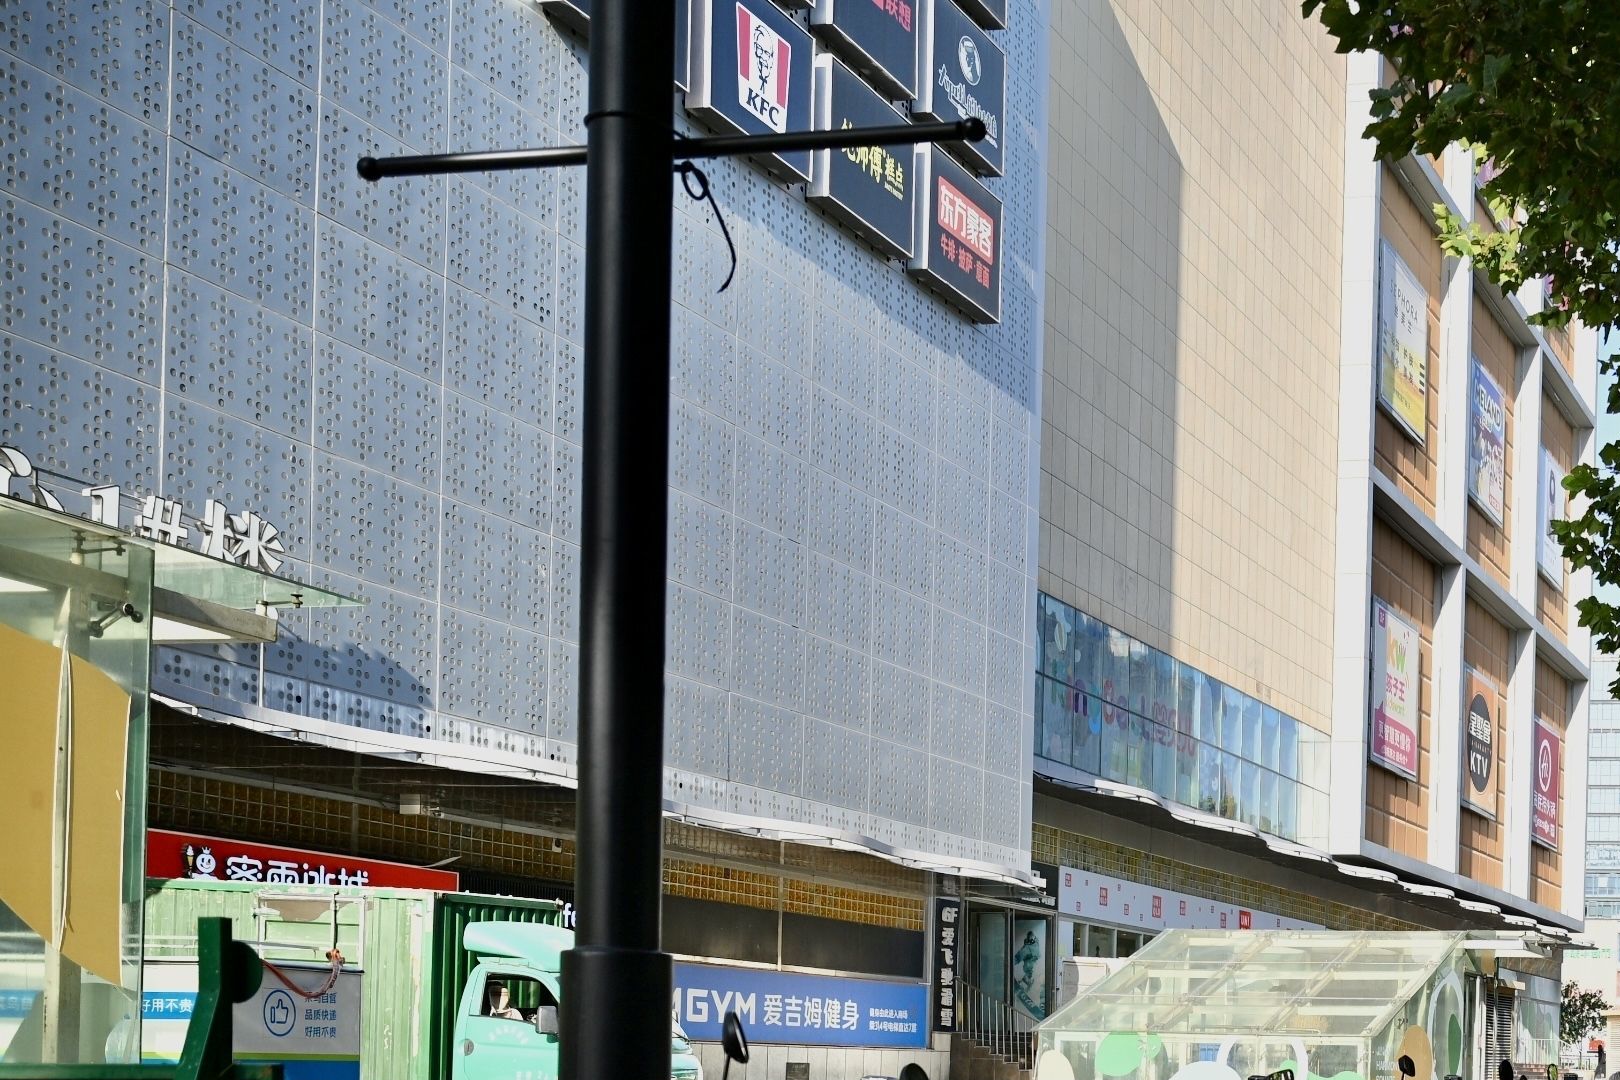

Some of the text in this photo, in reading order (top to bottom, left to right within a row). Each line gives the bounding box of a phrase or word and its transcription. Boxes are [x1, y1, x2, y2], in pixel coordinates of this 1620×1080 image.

[745, 86, 781, 129] KFC
[940, 184, 992, 258] 东方豪客
[1386, 672, 1405, 702] 孩子王
[1470, 750, 1488, 778] KTV
[763, 993, 860, 1031] 爱吉姆健身
[304, 1026, 337, 1038] 好用不贵
